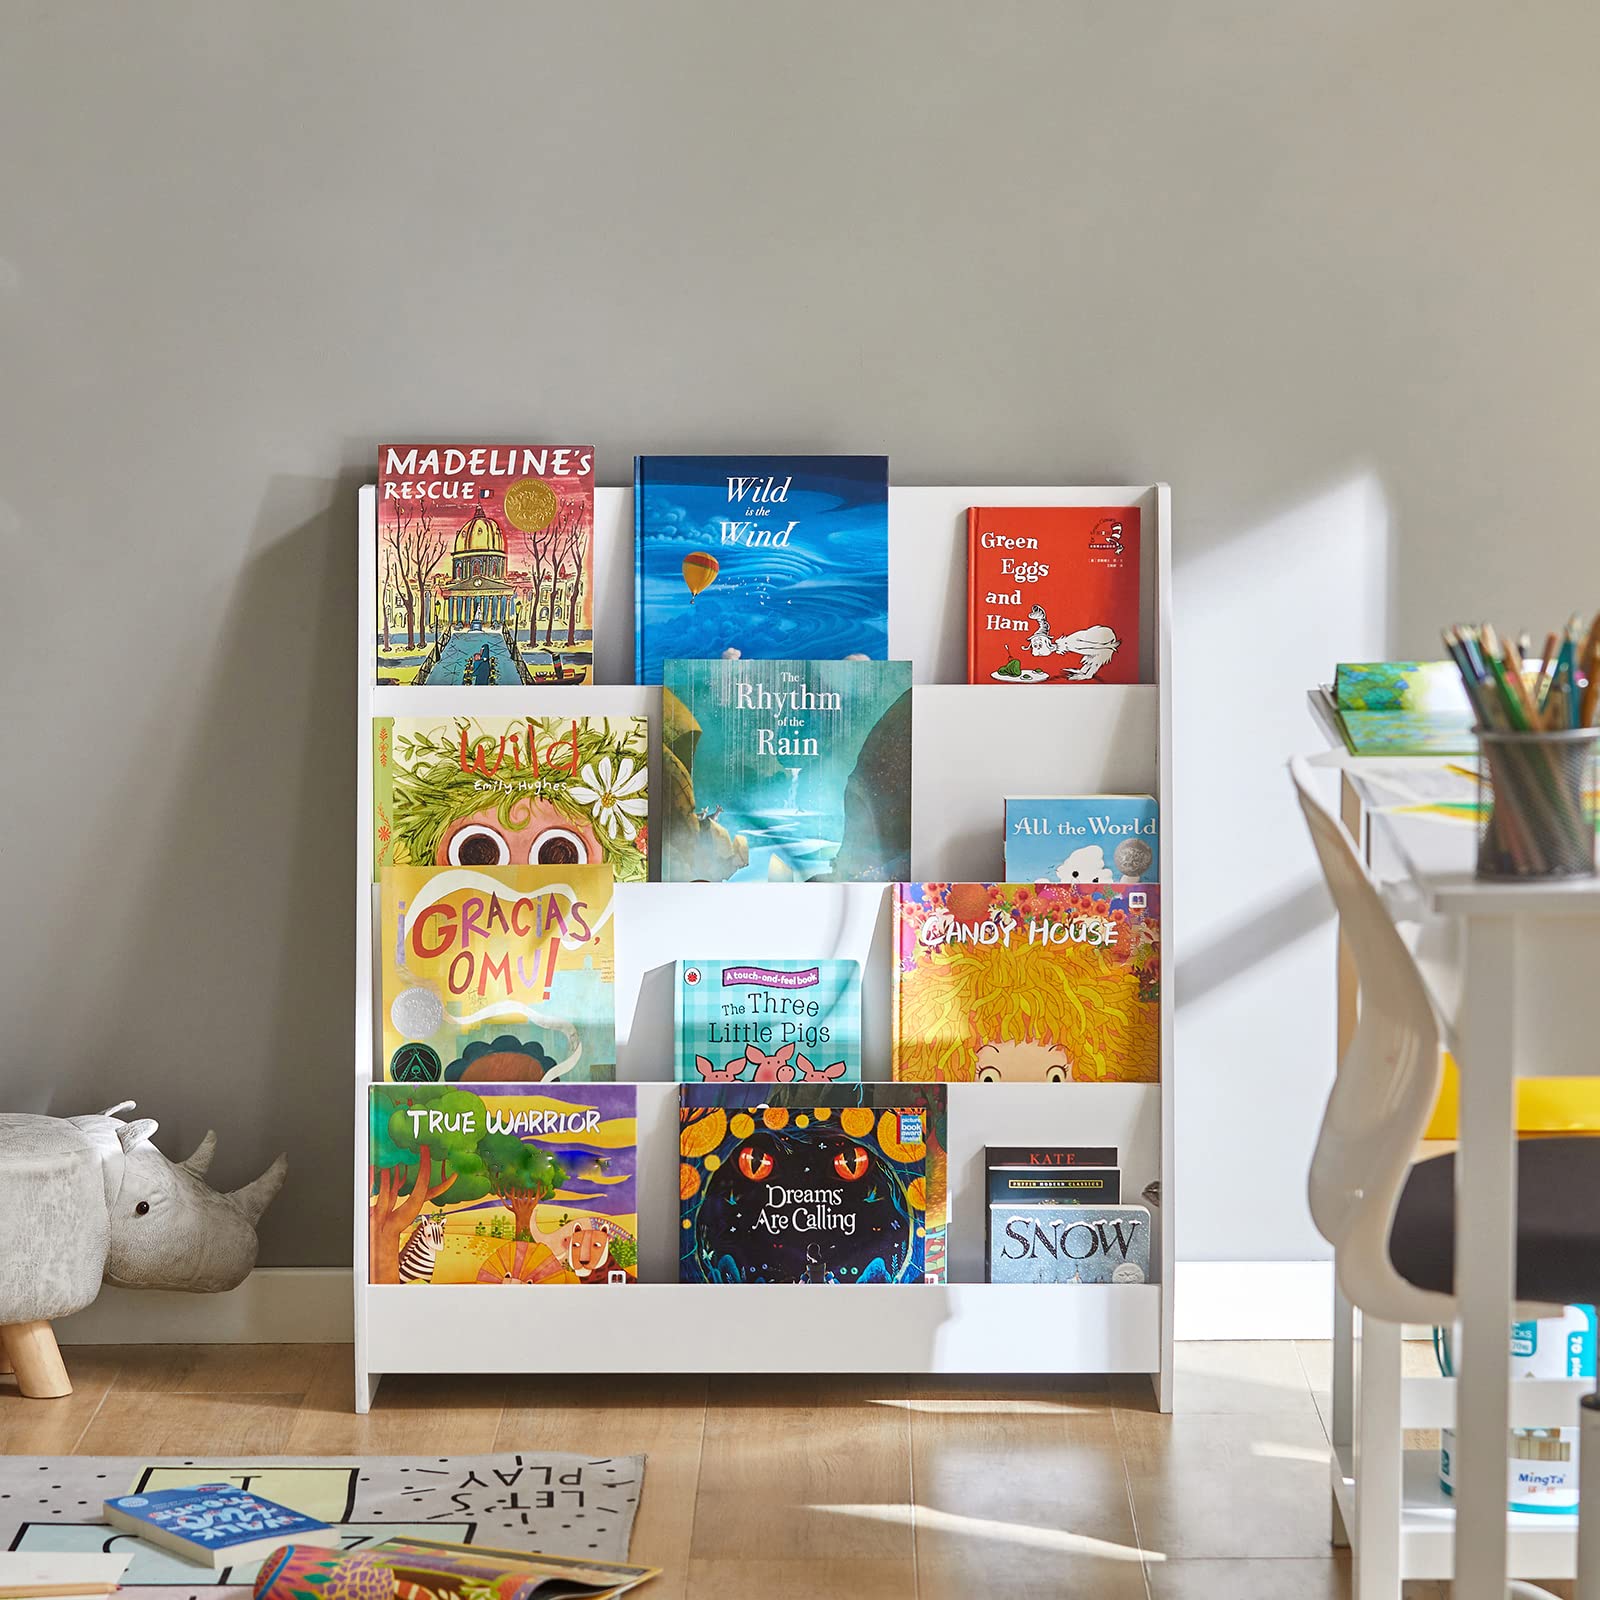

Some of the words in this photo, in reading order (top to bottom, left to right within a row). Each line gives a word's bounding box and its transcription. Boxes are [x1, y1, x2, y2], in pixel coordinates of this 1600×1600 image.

[385, 448, 592, 476] MADELINE'S
[384, 480, 475, 500] RESCUE
[726, 476, 793, 503] Wild
[745, 507, 754, 517] is
[755, 506, 771, 517] the
[719, 520, 801, 548] Wind
[981, 532, 1039, 550] Green
[1001, 558, 1050, 583] Eggs
[985, 589, 1022, 605] and
[986, 614, 1029, 631] Ham
[781, 672, 800, 682] The
[735, 683, 841, 718] Rhythm
[777, 716, 788, 727] of
[789, 717, 805, 727] the
[757, 728, 819, 756] Rain
[473, 779, 513, 795] Emily
[518, 778, 567, 795] Hughes
[1013, 816, 1052, 836] All
[1057, 821, 1087, 836] the
[1088, 815, 1158, 836] World
[921, 915, 1018, 948] CANDY
[1028, 918, 1120, 947] HOUSE
[448, 937, 560, 1001] OMU!
[726, 973, 733, 981] A
[733, 971, 797, 985] touch-and-feel
[797, 973, 817, 986] book
[721, 1003, 746, 1017] The
[747, 991, 819, 1017] Three
[708, 1022, 773, 1043] Little
[781, 1022, 831, 1048] Pigs
[407, 1109, 476, 1138] TRUE
[486, 1109, 600, 1136] WARRIOR
[901, 1123, 922, 1131] book
[1029, 1153, 1076, 1165] KATE
[765, 1184, 844, 1208] Dreams
[752, 1208, 789, 1235] Are
[791, 1205, 857, 1236] Calling
[1000, 1215, 1142, 1260] SNOW
[458, 1466, 582, 1489] PLAY
